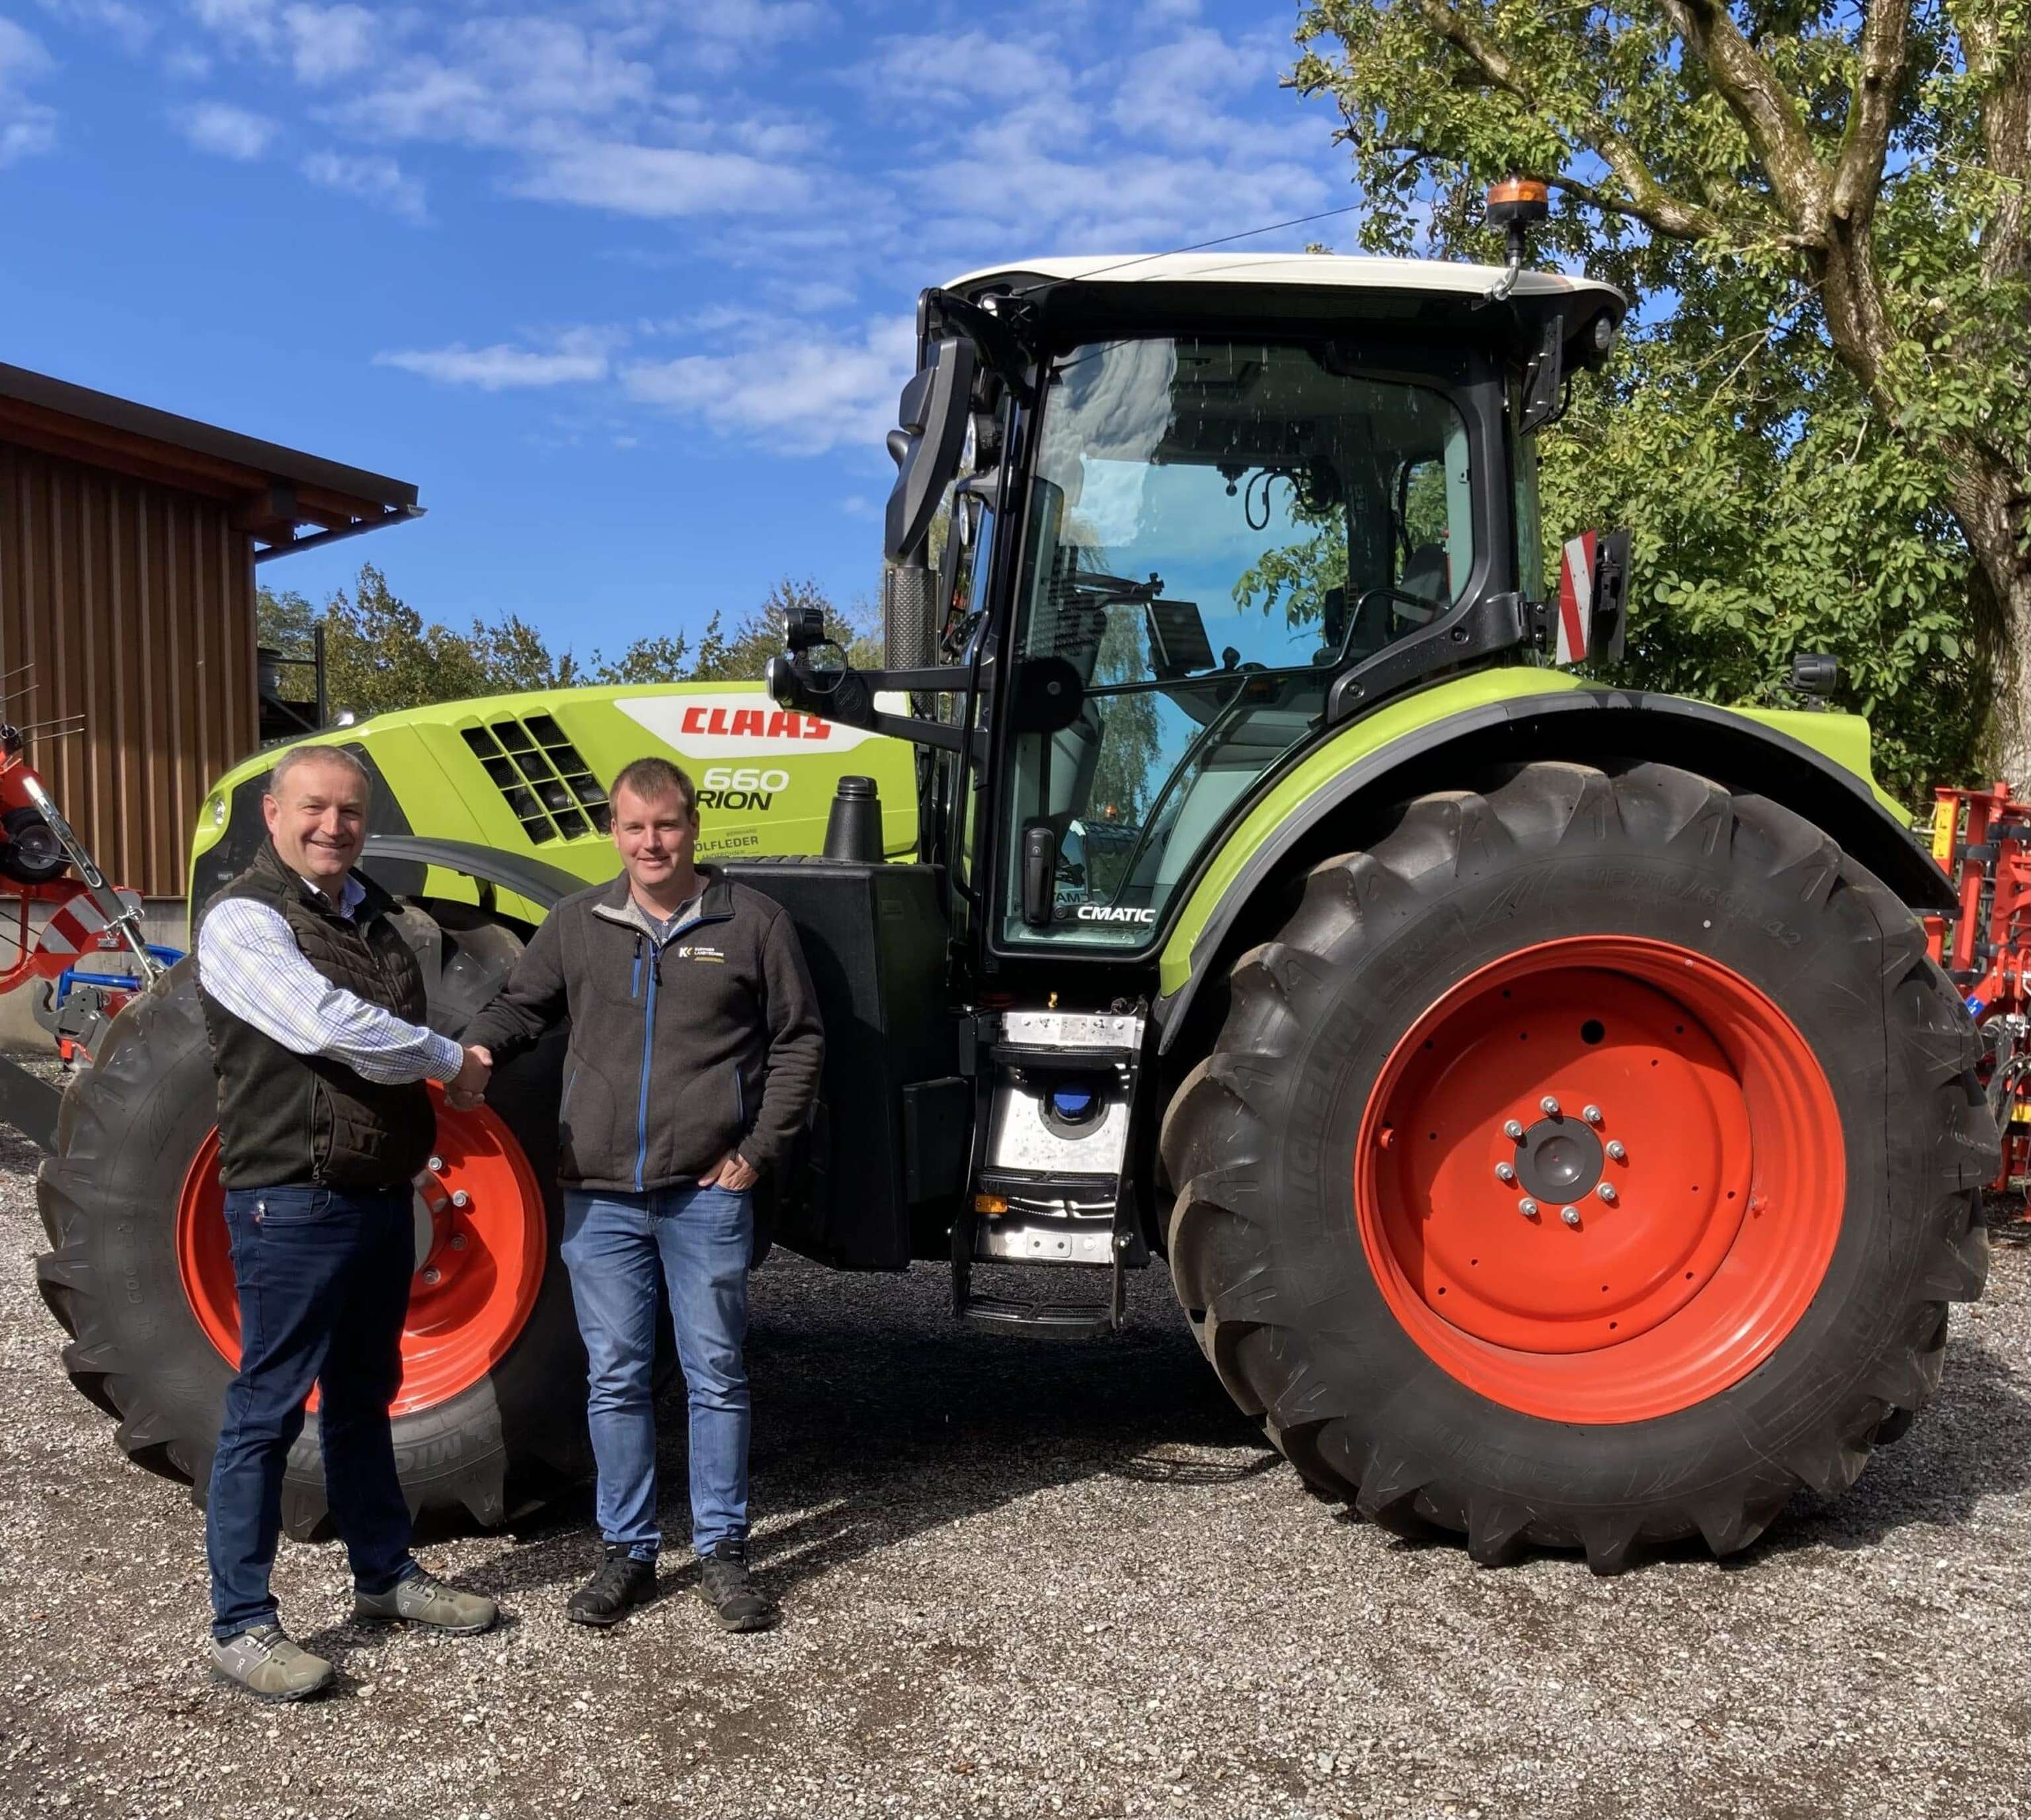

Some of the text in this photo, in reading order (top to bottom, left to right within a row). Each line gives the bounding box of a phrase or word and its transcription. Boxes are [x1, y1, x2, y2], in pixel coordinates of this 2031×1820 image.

[681, 707, 832, 740] CLAAS
[703, 768, 789, 792] 660
[696, 791, 773, 811] RION
[695, 836, 759, 852] ÖLFLEDER
[1077, 906, 1156, 923] CMATIC
